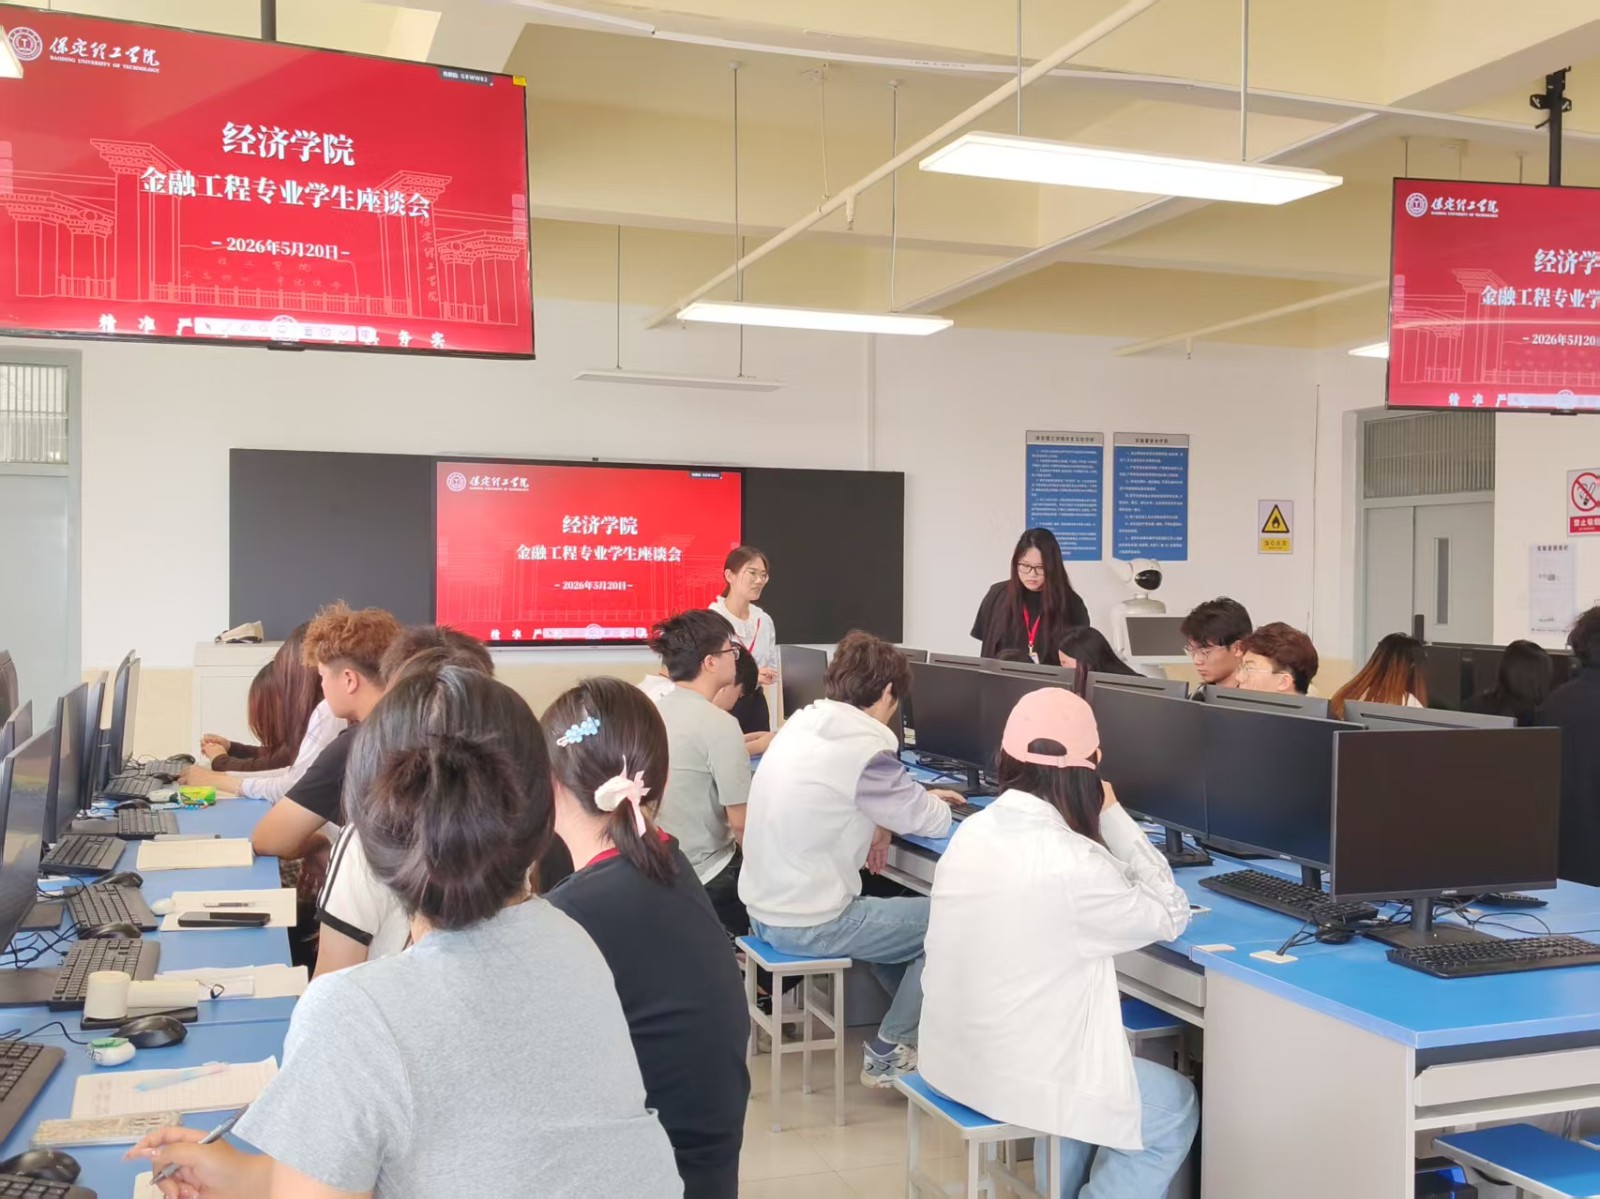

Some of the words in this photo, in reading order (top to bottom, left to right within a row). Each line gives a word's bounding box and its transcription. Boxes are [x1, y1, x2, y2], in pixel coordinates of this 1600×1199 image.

[49, 36, 160, 66] 保定理工学院
[78, 58, 111, 68] UNIVERSITY
[221, 121, 356, 167] 经济学院
[140, 166, 431, 219] 金融工程专业学生座谈会
[562, 515, 638, 535] 经济学院
[516, 545, 682, 562] 金融工程专业学生座谈会
